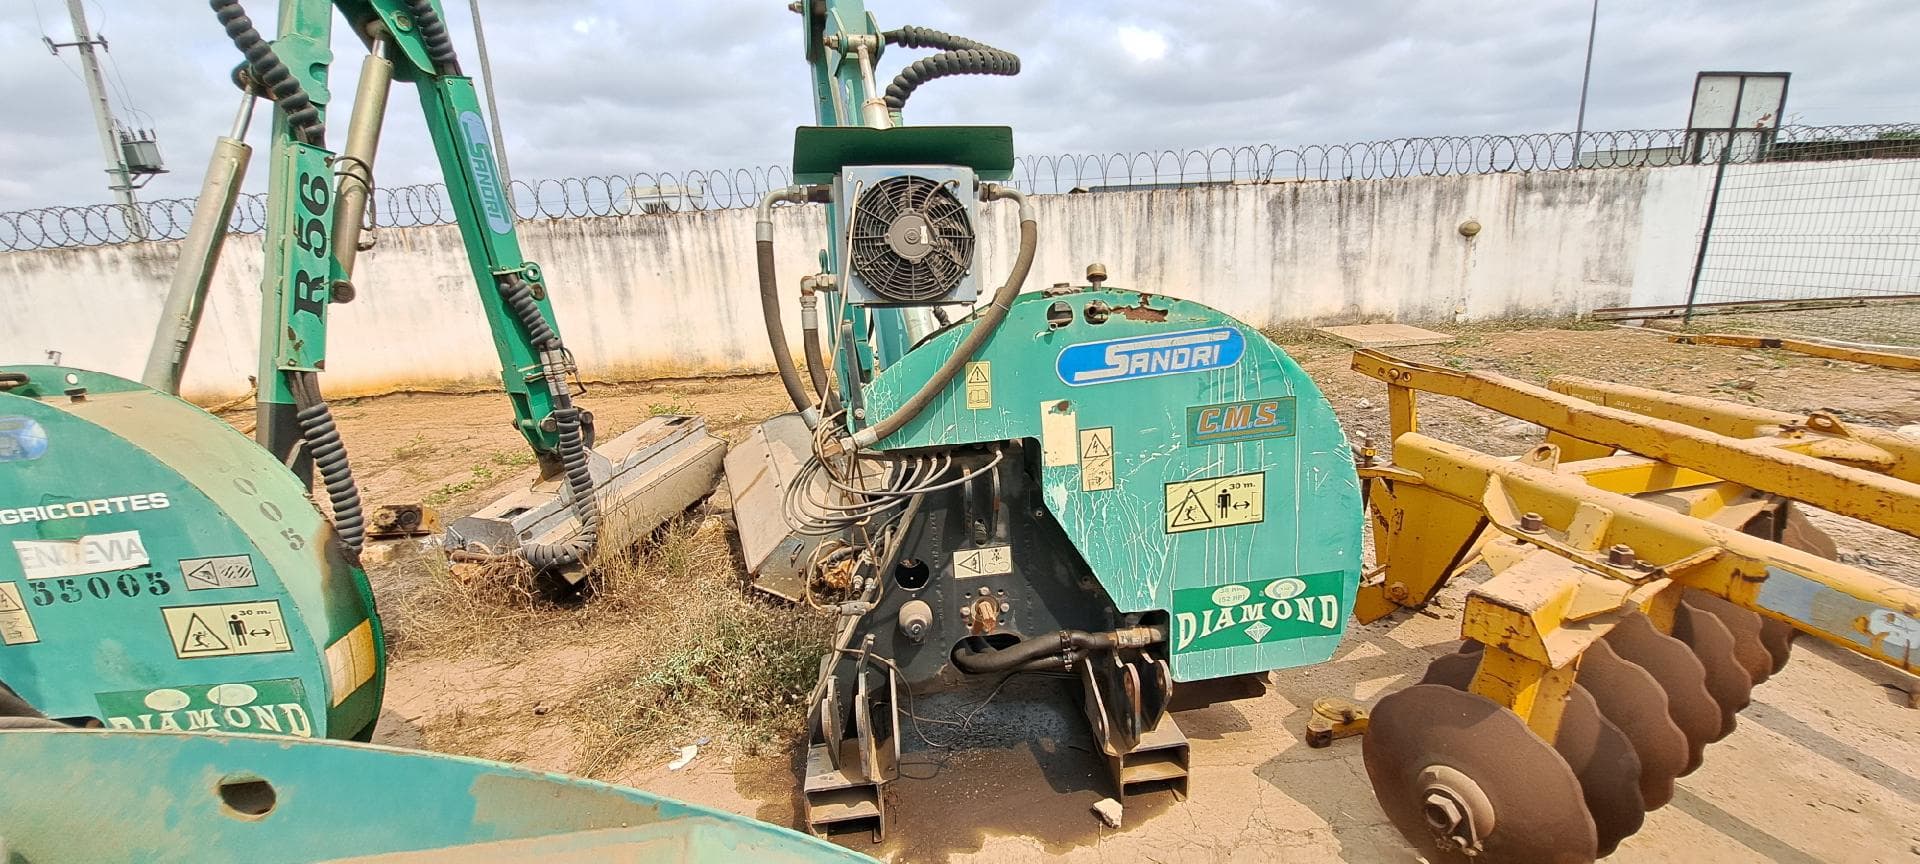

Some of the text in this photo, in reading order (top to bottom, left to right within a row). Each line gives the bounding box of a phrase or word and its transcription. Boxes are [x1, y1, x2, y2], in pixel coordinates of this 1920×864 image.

[462, 120, 510, 225] SANDRI
[293, 171, 330, 322] R 56
[1073, 331, 1231, 382] SANDRI
[1229, 482, 1241, 490] 30
[0, 492, 171, 525] GRICORTES
[28, 571, 171, 606] 55005
[1175, 594, 1339, 651] DIAMOND
[108, 702, 312, 738] IAMOND
